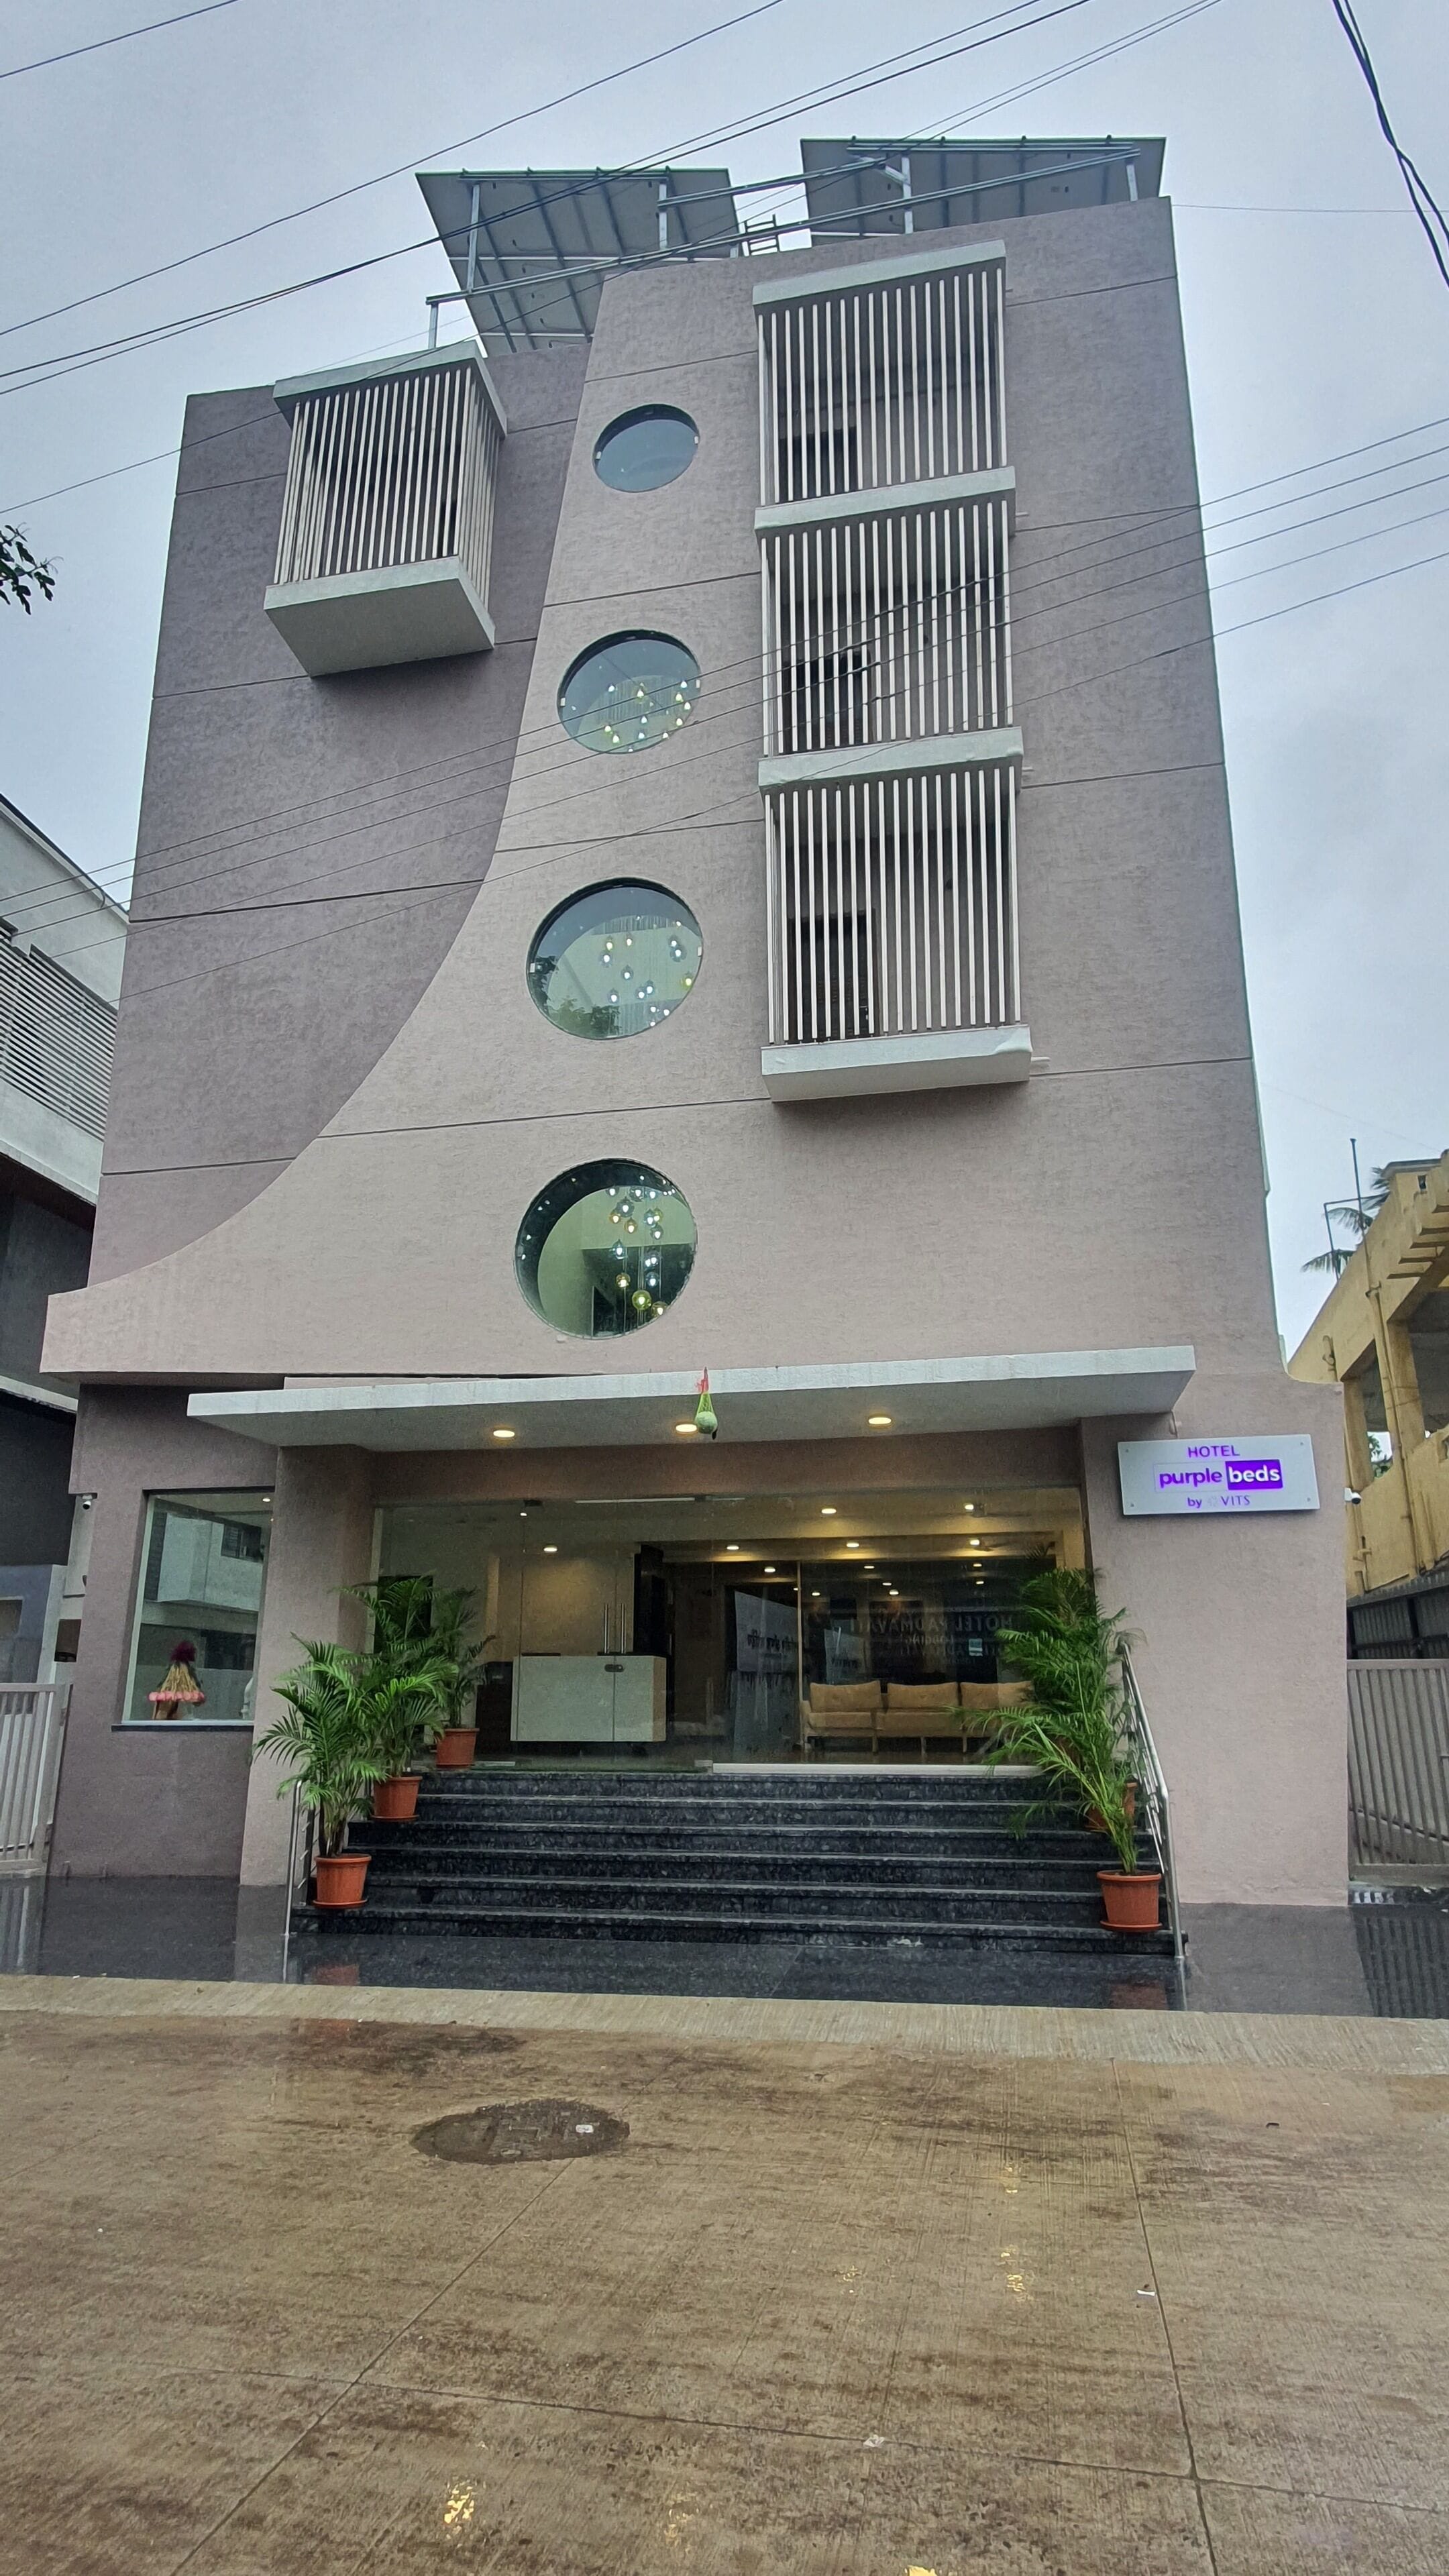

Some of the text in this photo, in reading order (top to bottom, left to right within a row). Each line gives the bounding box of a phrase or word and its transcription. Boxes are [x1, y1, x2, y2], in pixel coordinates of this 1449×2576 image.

[1188, 1445, 1240, 1458] HOTEL
[1159, 1465, 1281, 1488] purple beds
[1187, 1495, 1250, 1509] by VITS
